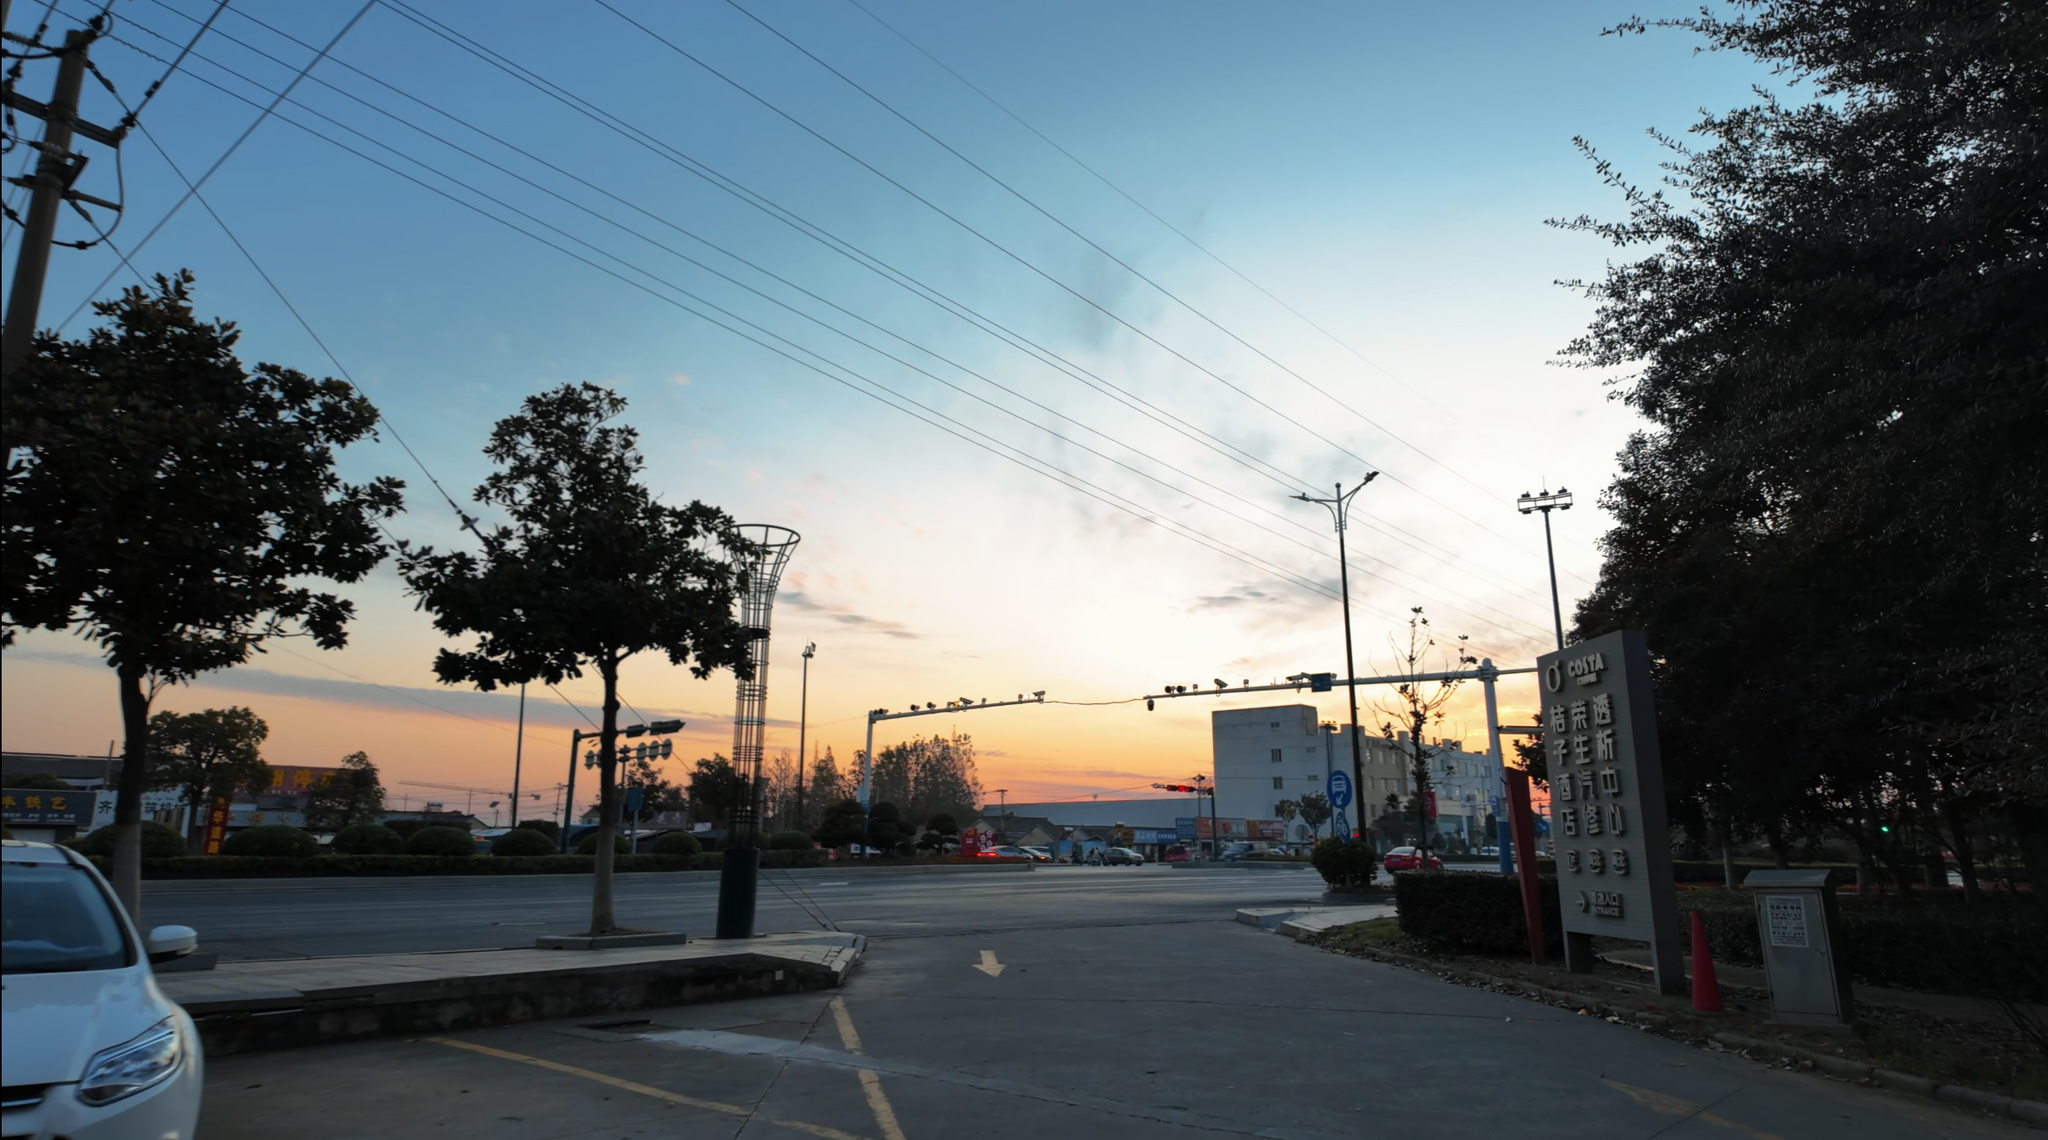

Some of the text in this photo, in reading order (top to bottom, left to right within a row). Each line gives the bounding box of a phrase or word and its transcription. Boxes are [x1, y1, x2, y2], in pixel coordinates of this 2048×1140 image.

[1567, 653, 1605, 677] COSTA
[1549, 704, 1578, 837] 桔子酒店
[1570, 699, 1602, 835] 荣生汽修
[1592, 692, 1625, 835] 透析中心
